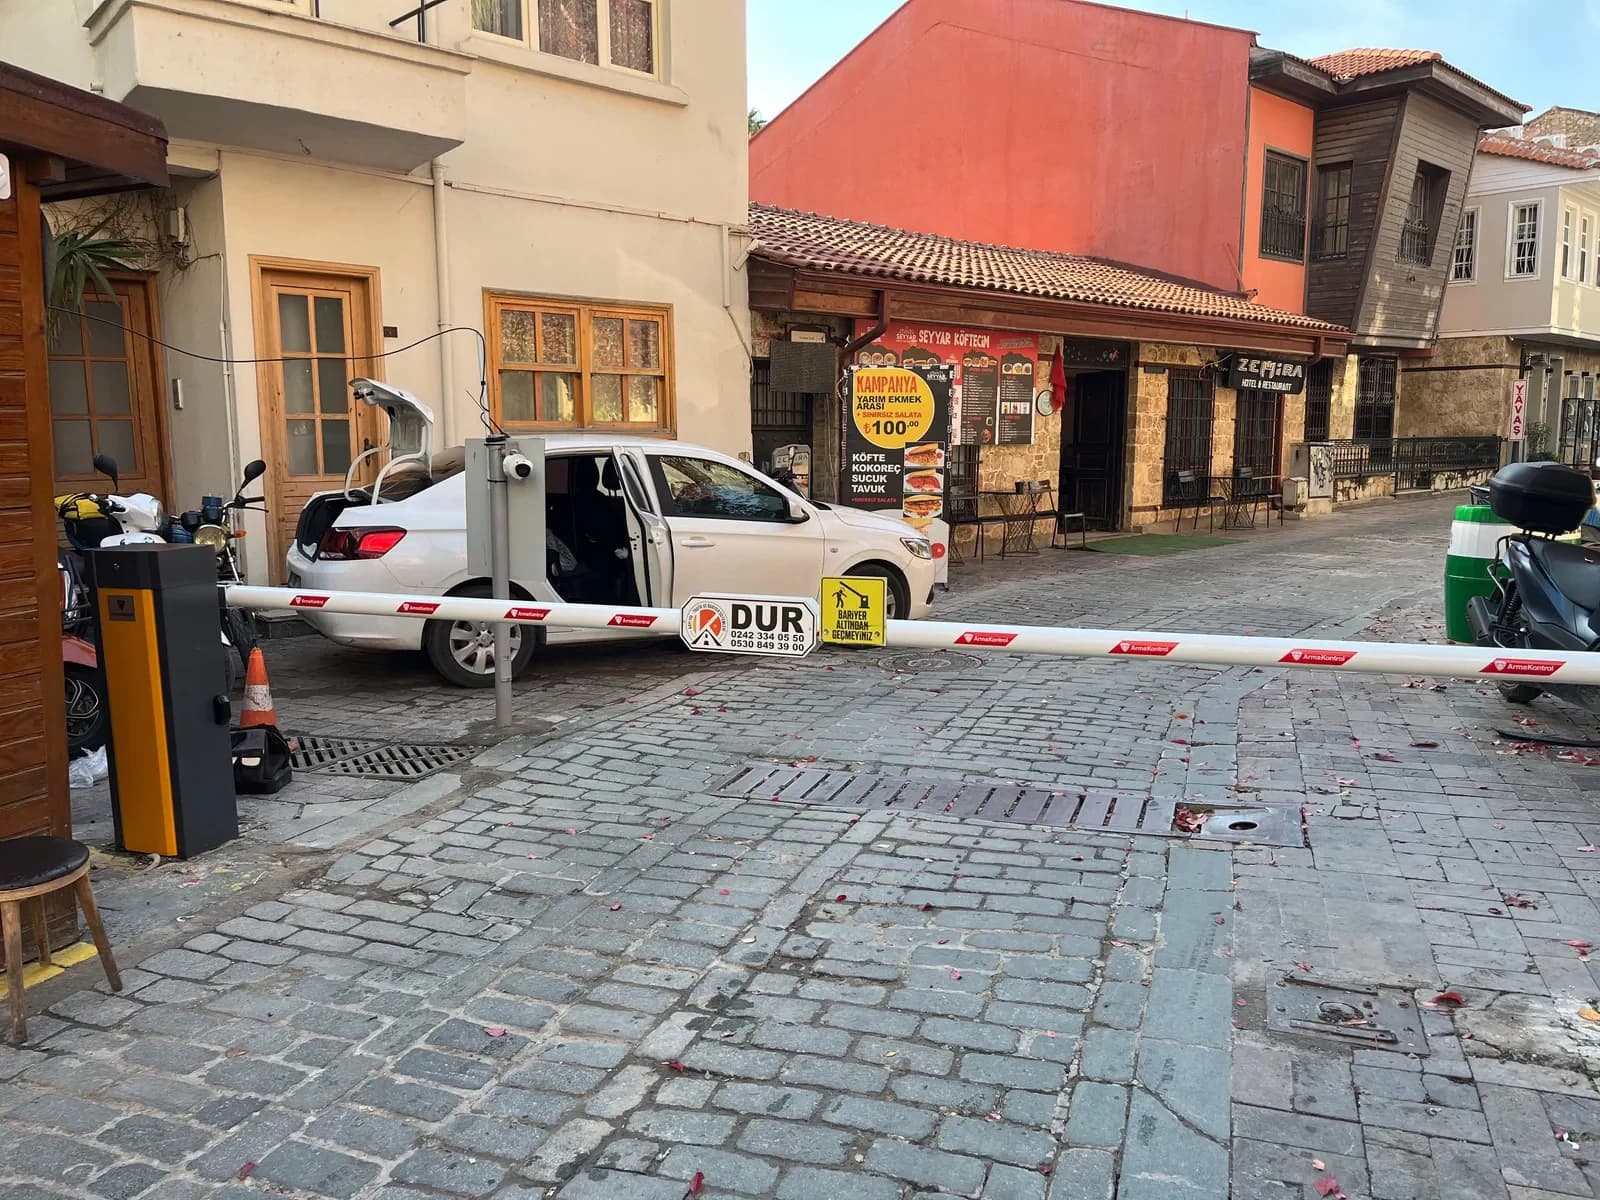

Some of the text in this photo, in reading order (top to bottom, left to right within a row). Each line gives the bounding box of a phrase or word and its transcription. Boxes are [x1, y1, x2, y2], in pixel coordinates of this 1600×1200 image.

[919, 329, 951, 345] SEYYAR
[856, 375, 918, 393] KAMPANYA
[1241, 378, 1257, 388] HOTEL
[1262, 380, 1293, 391] RESTAURANT
[857, 395, 922, 404] YARIM EKMEK
[856, 402, 885, 410] ARASI
[1513, 385, 1524, 436] YAVAŞ
[852, 452, 886, 462] KÖFTE
[852, 463, 901, 474] KOKOREÇ
[852, 474, 888, 483] SUCUK
[851, 484, 886, 493] TAVUK
[731, 604, 804, 633] DUR
[836, 620, 869, 630] ALTINDAN
[731, 631, 754, 639] 0242
[757, 632, 775, 640] 334
[778, 633, 790, 641] 05
[731, 640, 805, 651] 0530 849 39 00
[1131, 644, 1169, 652] ArmaKontrol
[1303, 654, 1346, 662] ArmaKontrol
[1507, 663, 1554, 672] ArmaKontrol
